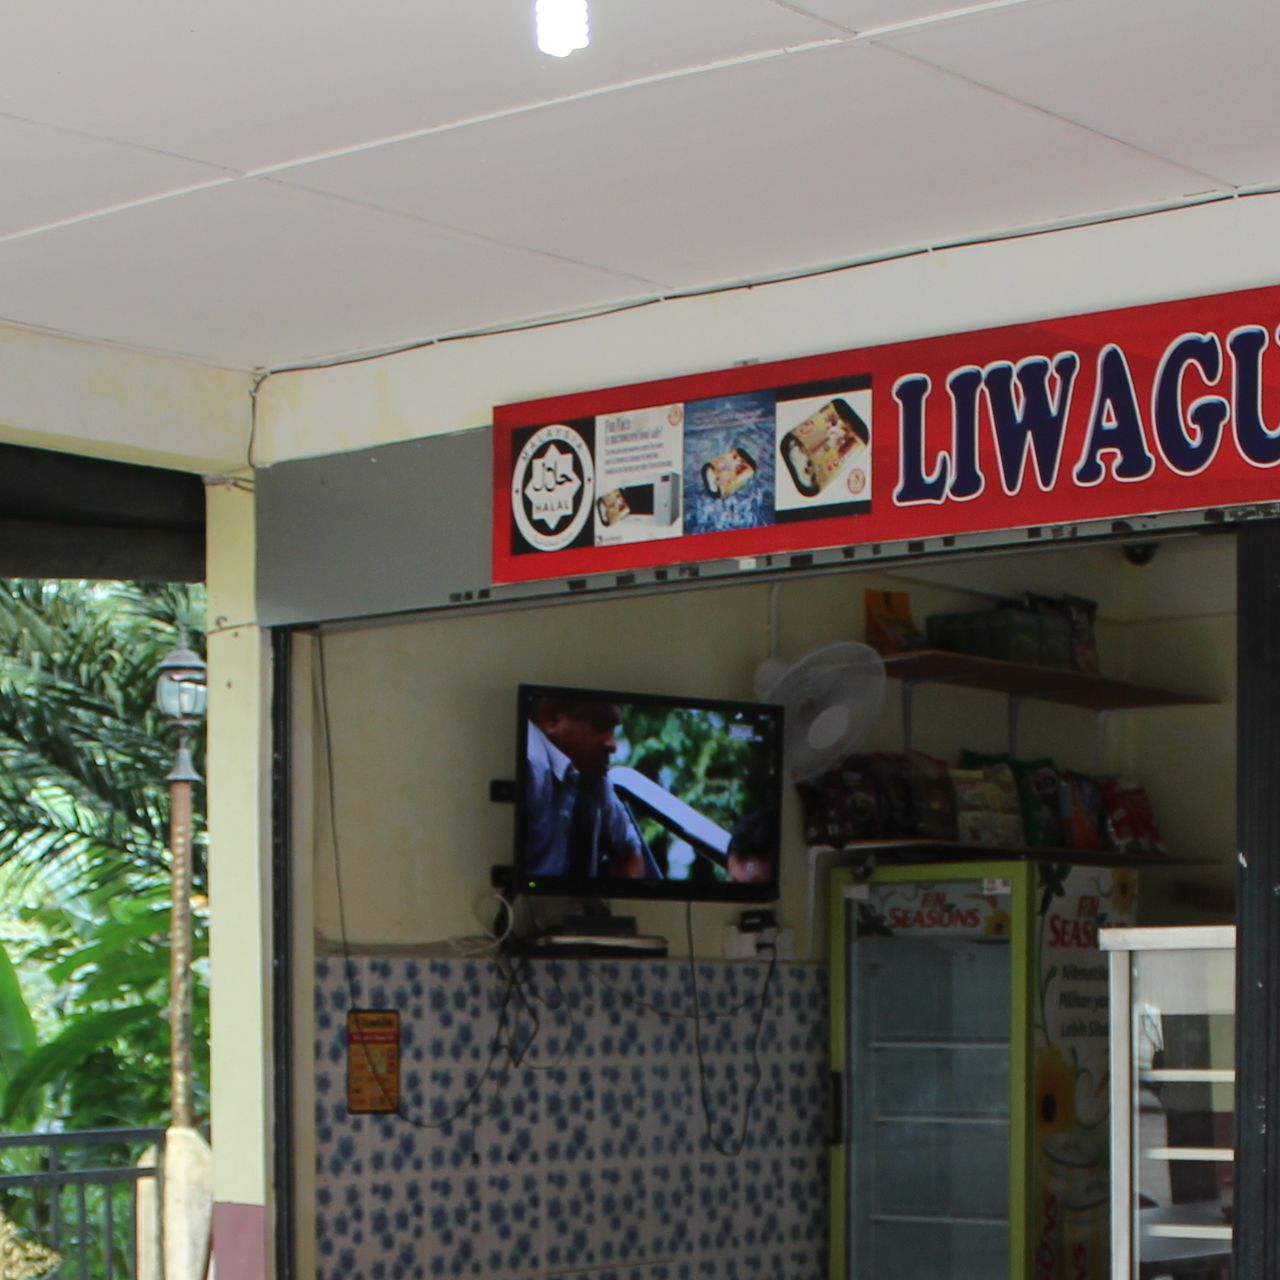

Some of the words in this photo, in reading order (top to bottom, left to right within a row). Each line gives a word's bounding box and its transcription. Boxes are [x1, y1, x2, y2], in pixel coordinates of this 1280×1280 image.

[521, 428, 583, 461] MALAYSIA
[532, 460, 573, 492] حلال
[535, 500, 570, 512] HALAL
[888, 907, 981, 929] SEASONS
